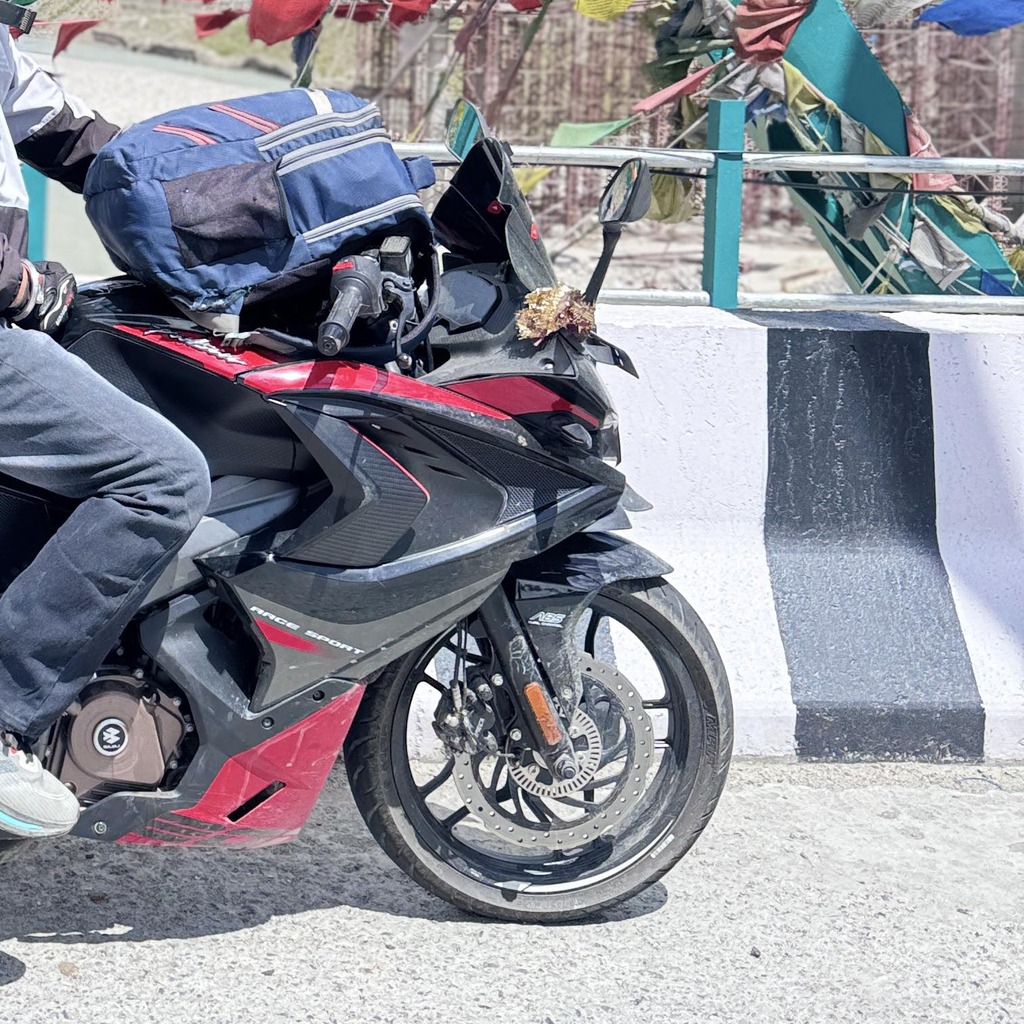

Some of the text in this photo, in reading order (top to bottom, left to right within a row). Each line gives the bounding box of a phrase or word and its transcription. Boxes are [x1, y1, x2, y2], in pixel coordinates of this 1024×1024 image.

[249, 605, 365, 655] RACE SPORT
[529, 611, 567, 624] ABS
